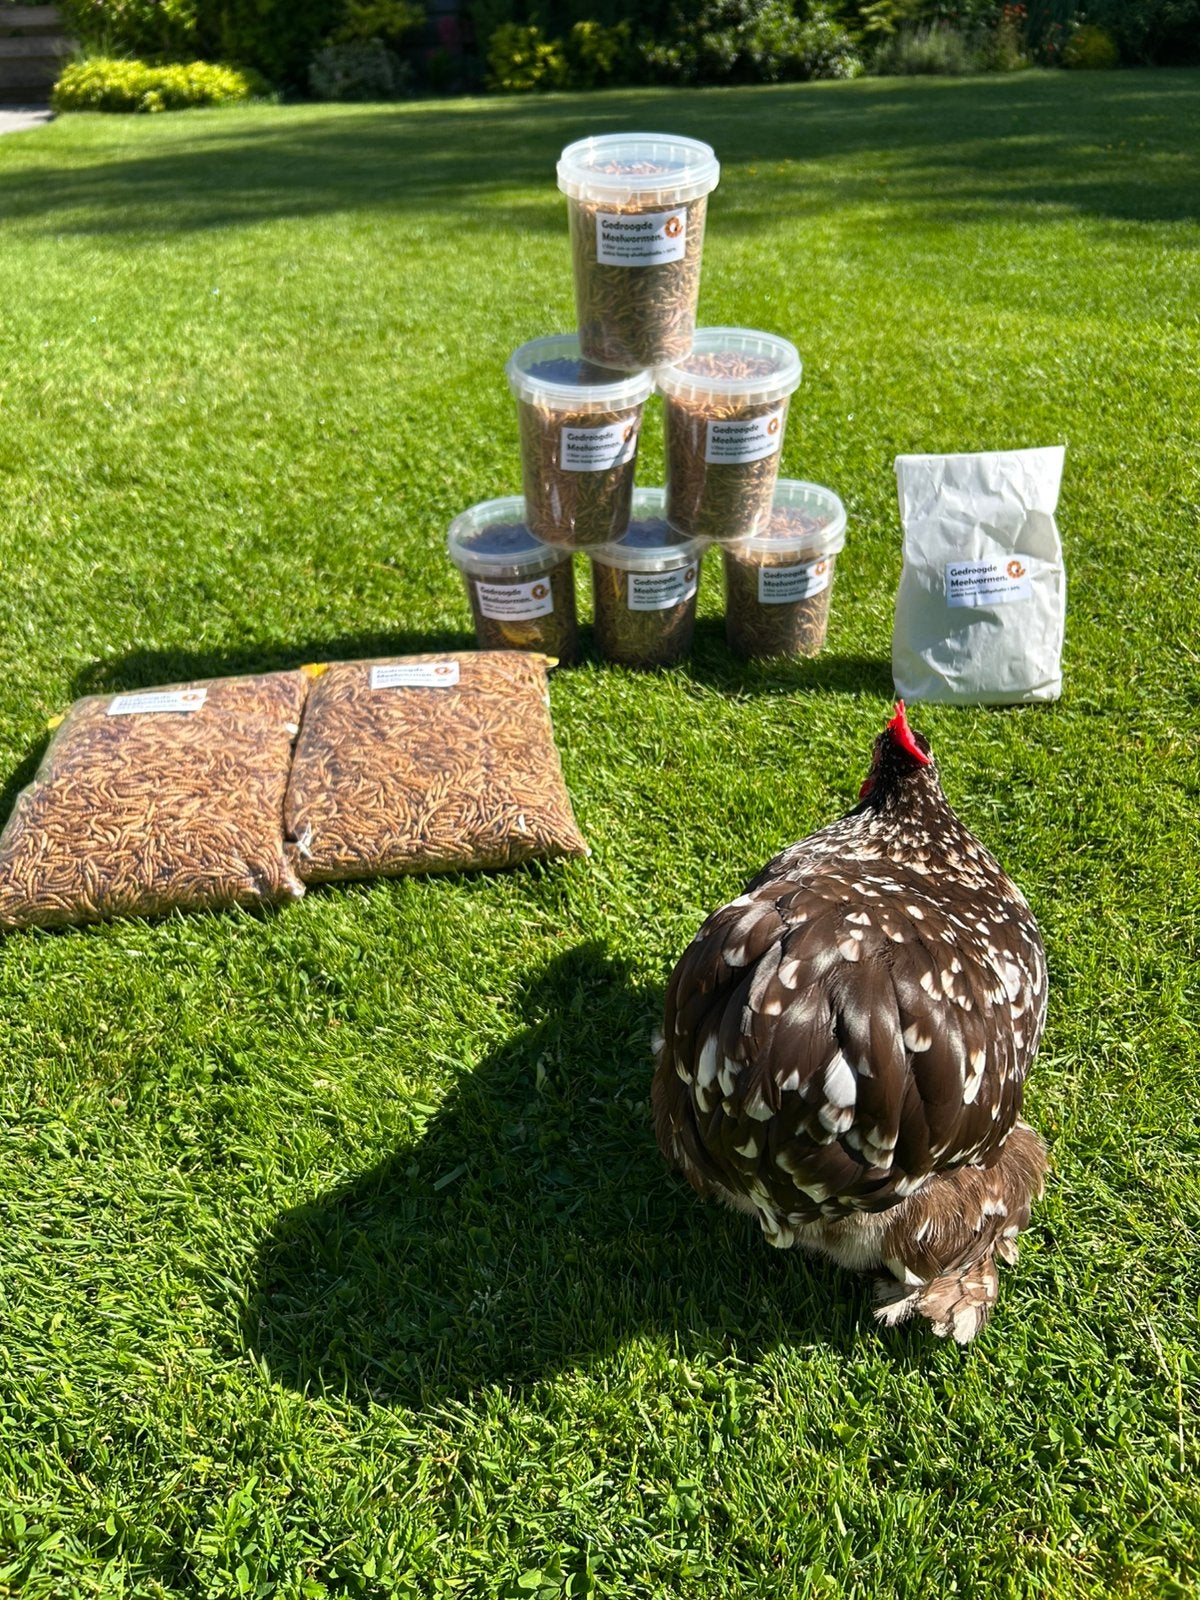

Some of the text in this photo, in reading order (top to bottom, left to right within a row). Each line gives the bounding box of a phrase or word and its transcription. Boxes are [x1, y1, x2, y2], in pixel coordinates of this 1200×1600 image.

[601, 219, 653, 231] Gedroogde
[602, 232, 664, 243] Meelwormen.
[711, 424, 759, 434] Gedroogde
[567, 432, 614, 441] Gedroogde
[763, 569, 807, 578] Gedroogde
[950, 564, 997, 576] Gedroogde
[950, 575, 1008, 587] Meelwormen.
